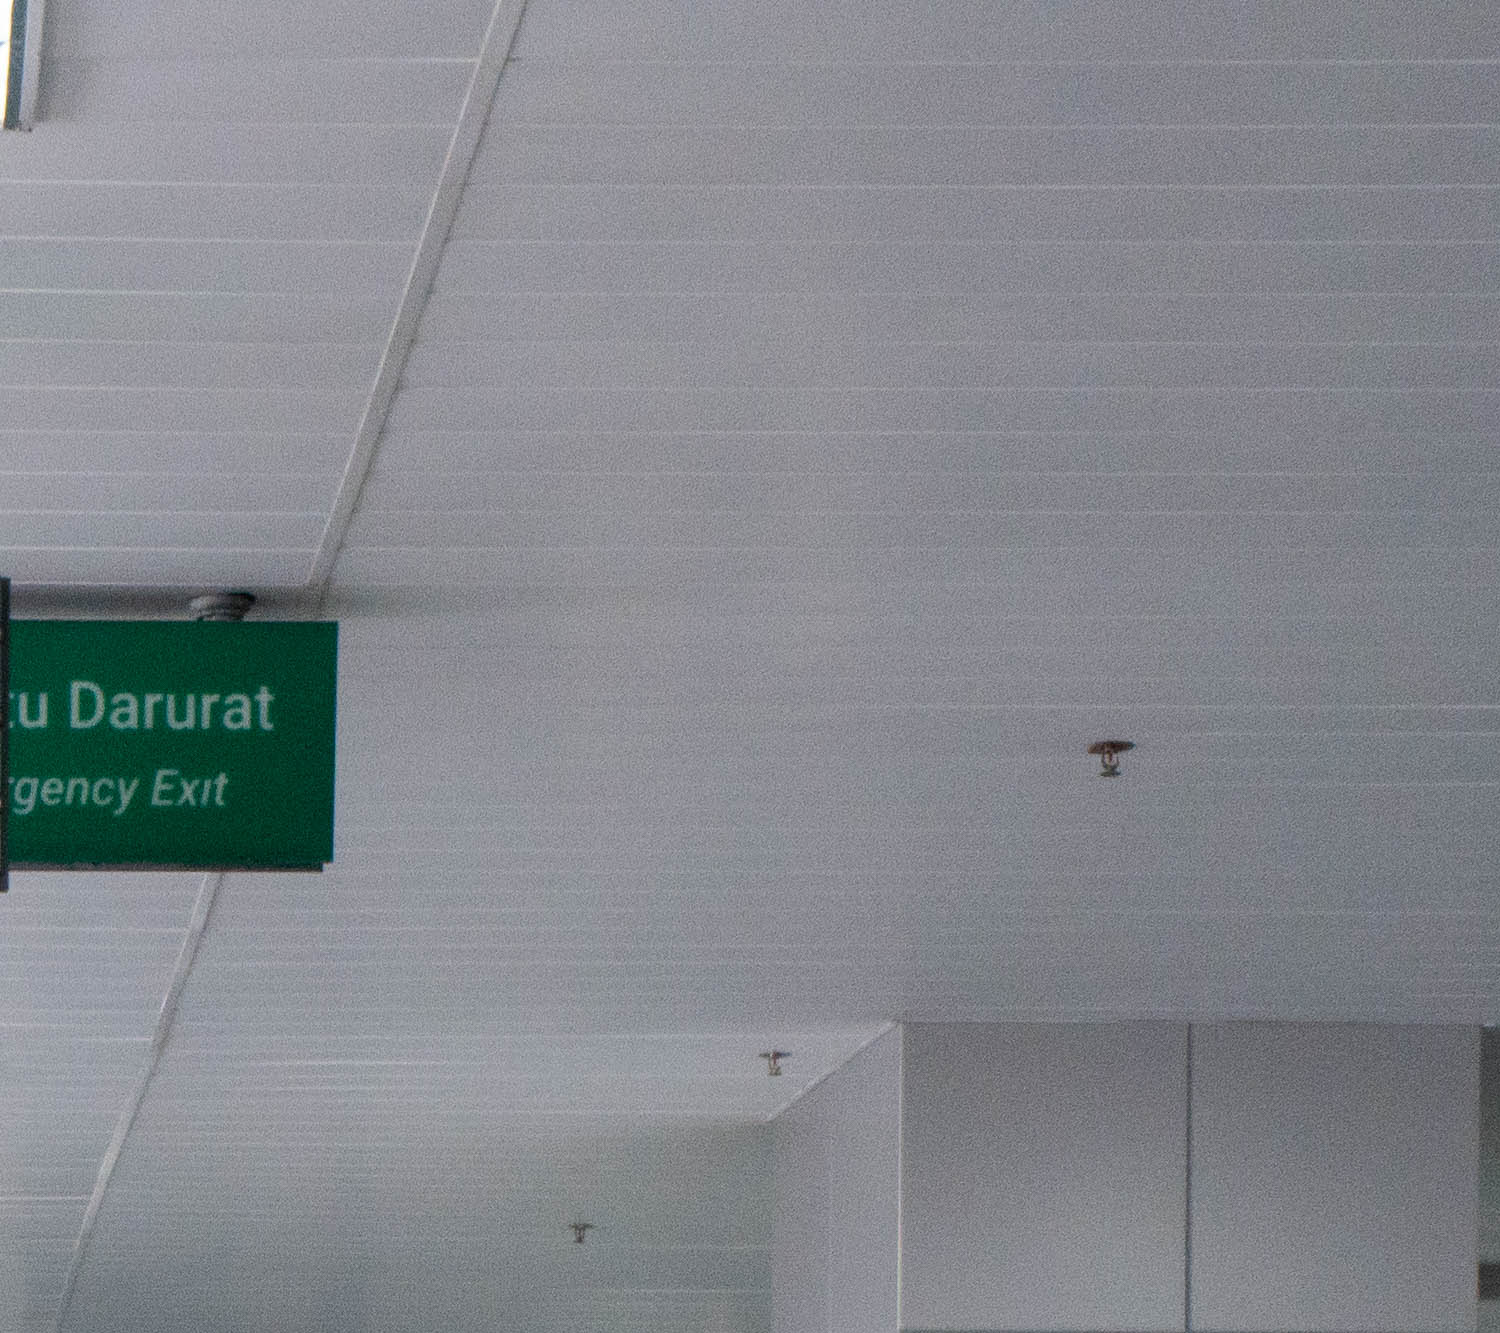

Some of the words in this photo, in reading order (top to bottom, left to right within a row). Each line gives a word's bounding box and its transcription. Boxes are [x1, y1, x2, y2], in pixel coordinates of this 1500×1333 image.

[70, 679, 275, 731] Darurat
[8, 775, 140, 816] gency
[151, 768, 229, 807] Exit
